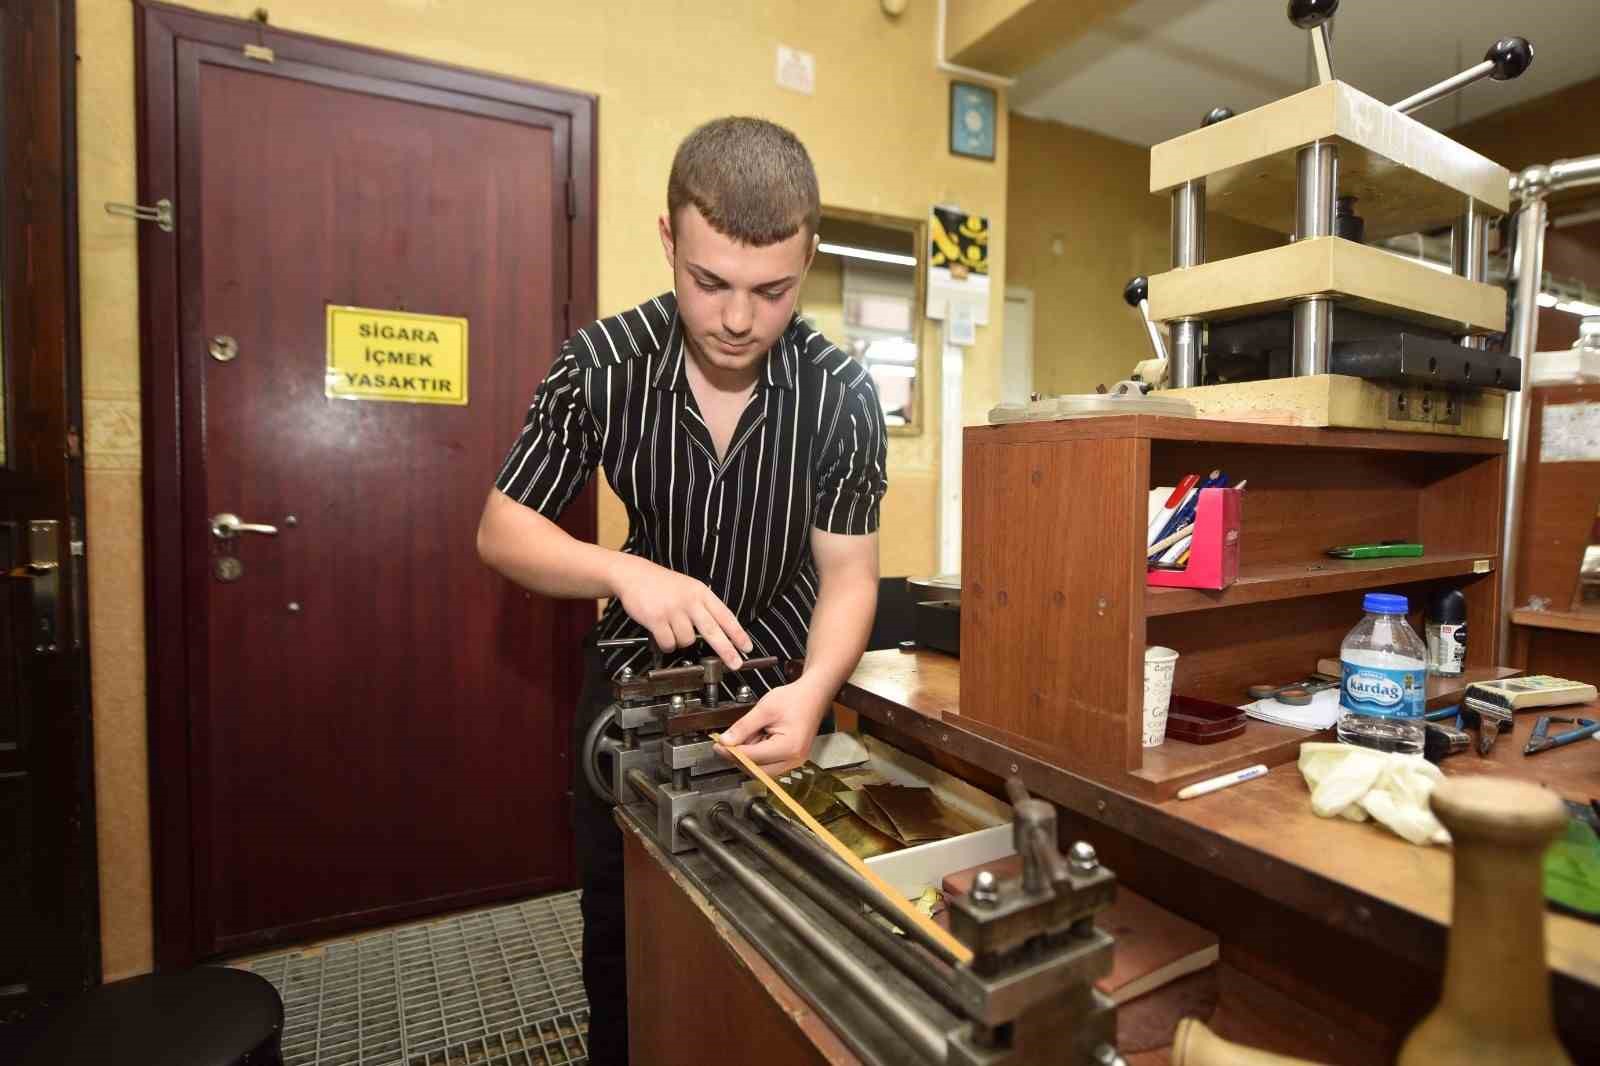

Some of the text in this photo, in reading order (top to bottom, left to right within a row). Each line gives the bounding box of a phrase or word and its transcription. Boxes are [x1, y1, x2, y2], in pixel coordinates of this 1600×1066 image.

[359, 323, 439, 344] SİGARA
[365, 347, 432, 366] İÇMEK
[345, 373, 452, 392] YASAKTIR
